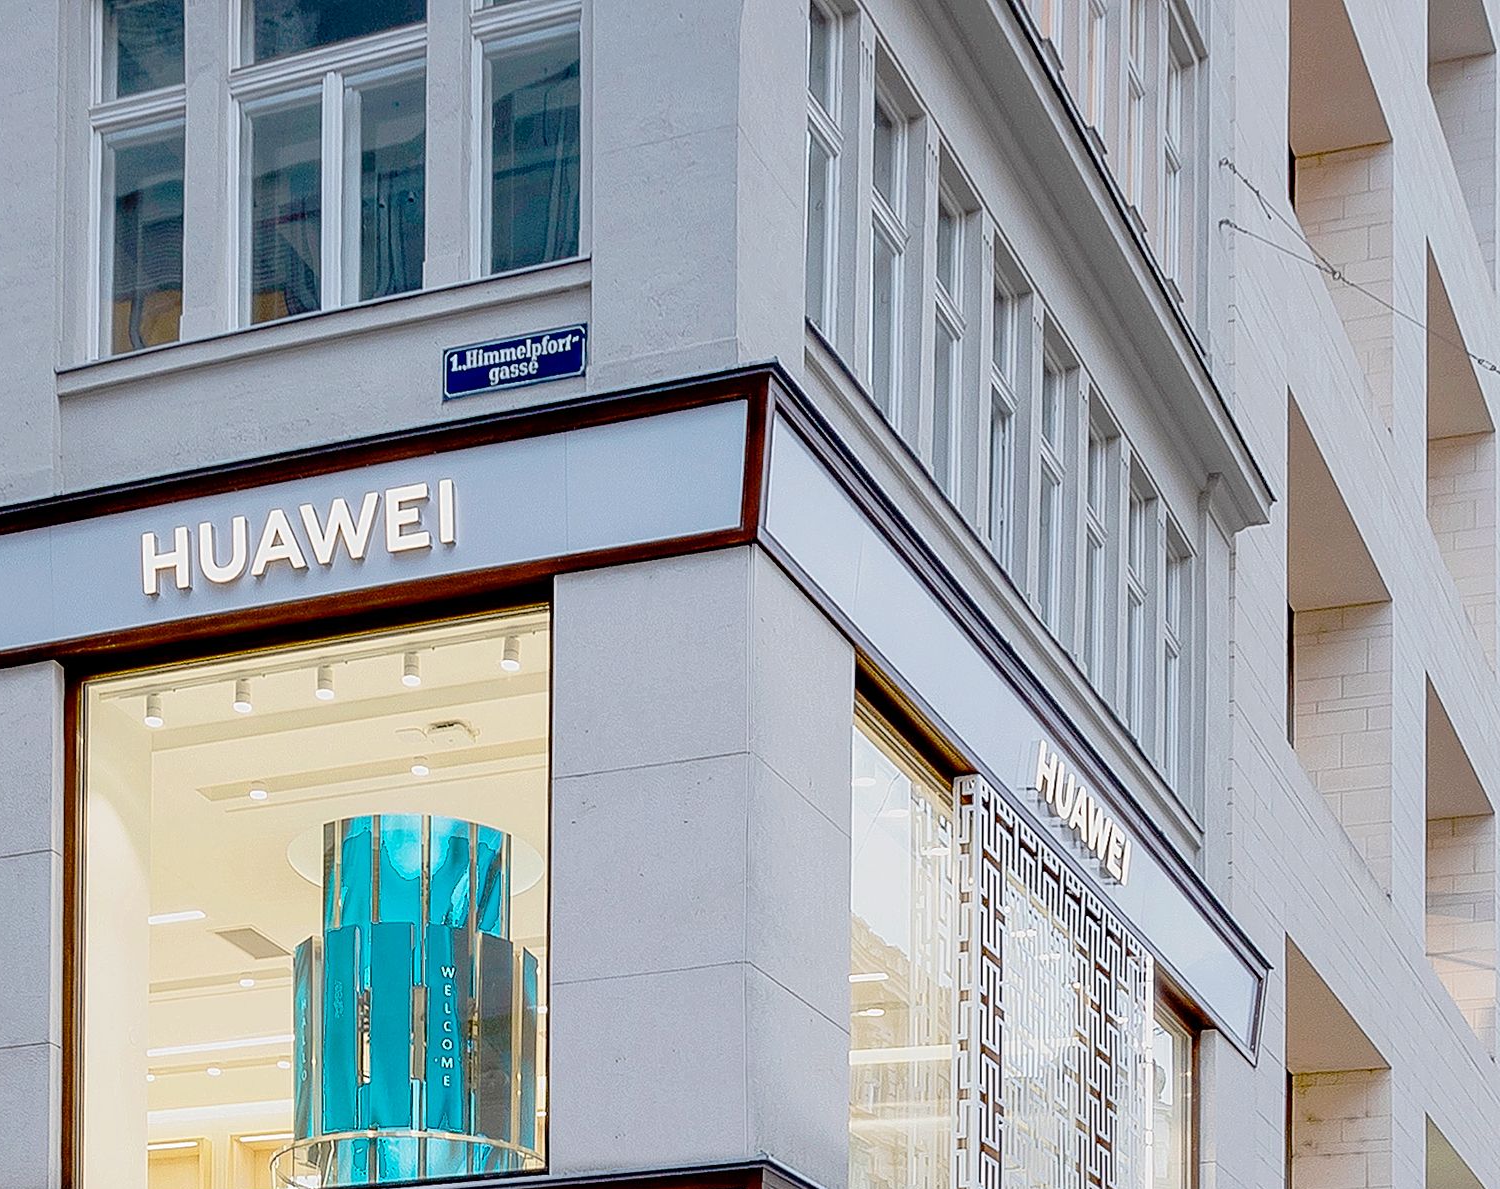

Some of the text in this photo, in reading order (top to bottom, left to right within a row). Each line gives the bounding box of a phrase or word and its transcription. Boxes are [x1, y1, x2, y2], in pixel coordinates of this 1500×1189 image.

[488, 360, 539, 386] gasse
[141, 478, 455, 595] HUAWEI
[1036, 739, 1132, 887] HUAWEI
[441, 966, 455, 1087] WELCOME
